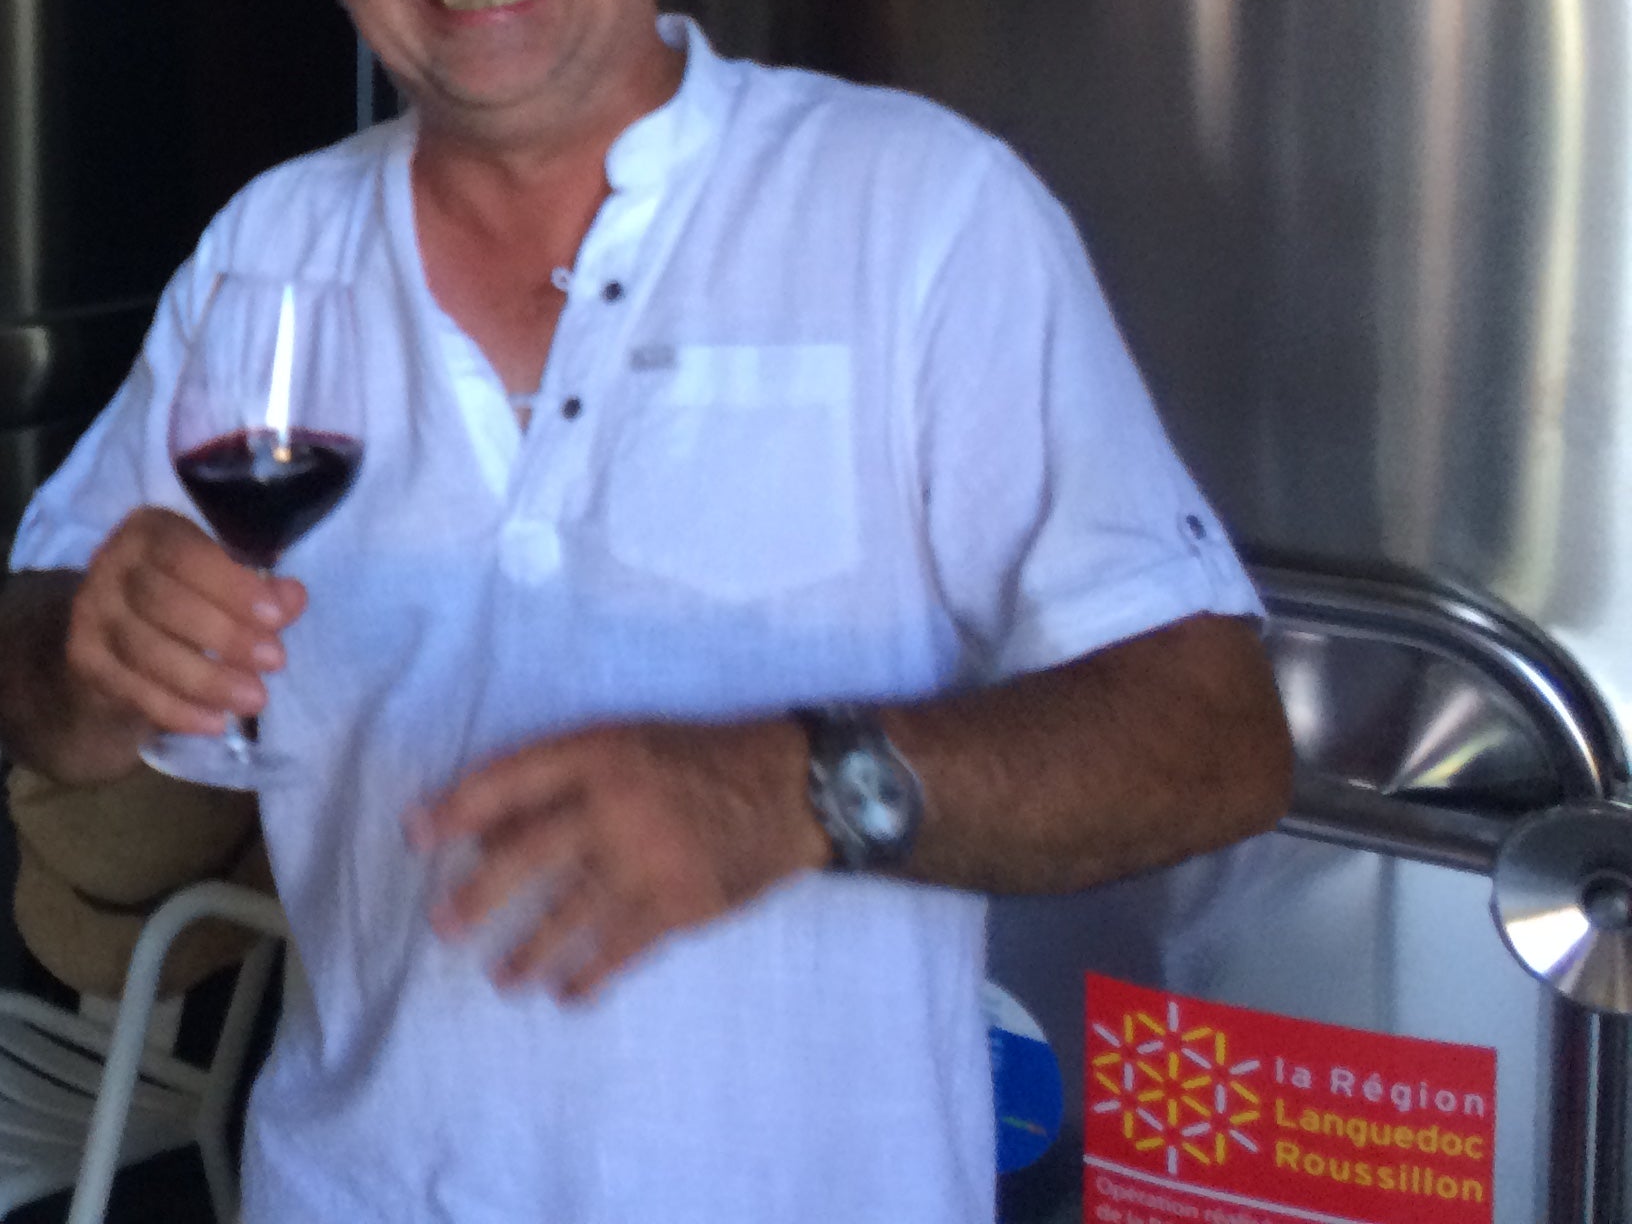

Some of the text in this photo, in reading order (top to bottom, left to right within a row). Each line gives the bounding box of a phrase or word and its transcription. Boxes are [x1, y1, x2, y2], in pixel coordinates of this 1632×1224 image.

[1275, 1056, 1485, 1117] la Région
[1275, 1099, 1484, 1160] Languedoc
[1275, 1140, 1484, 1203] Roussillon
